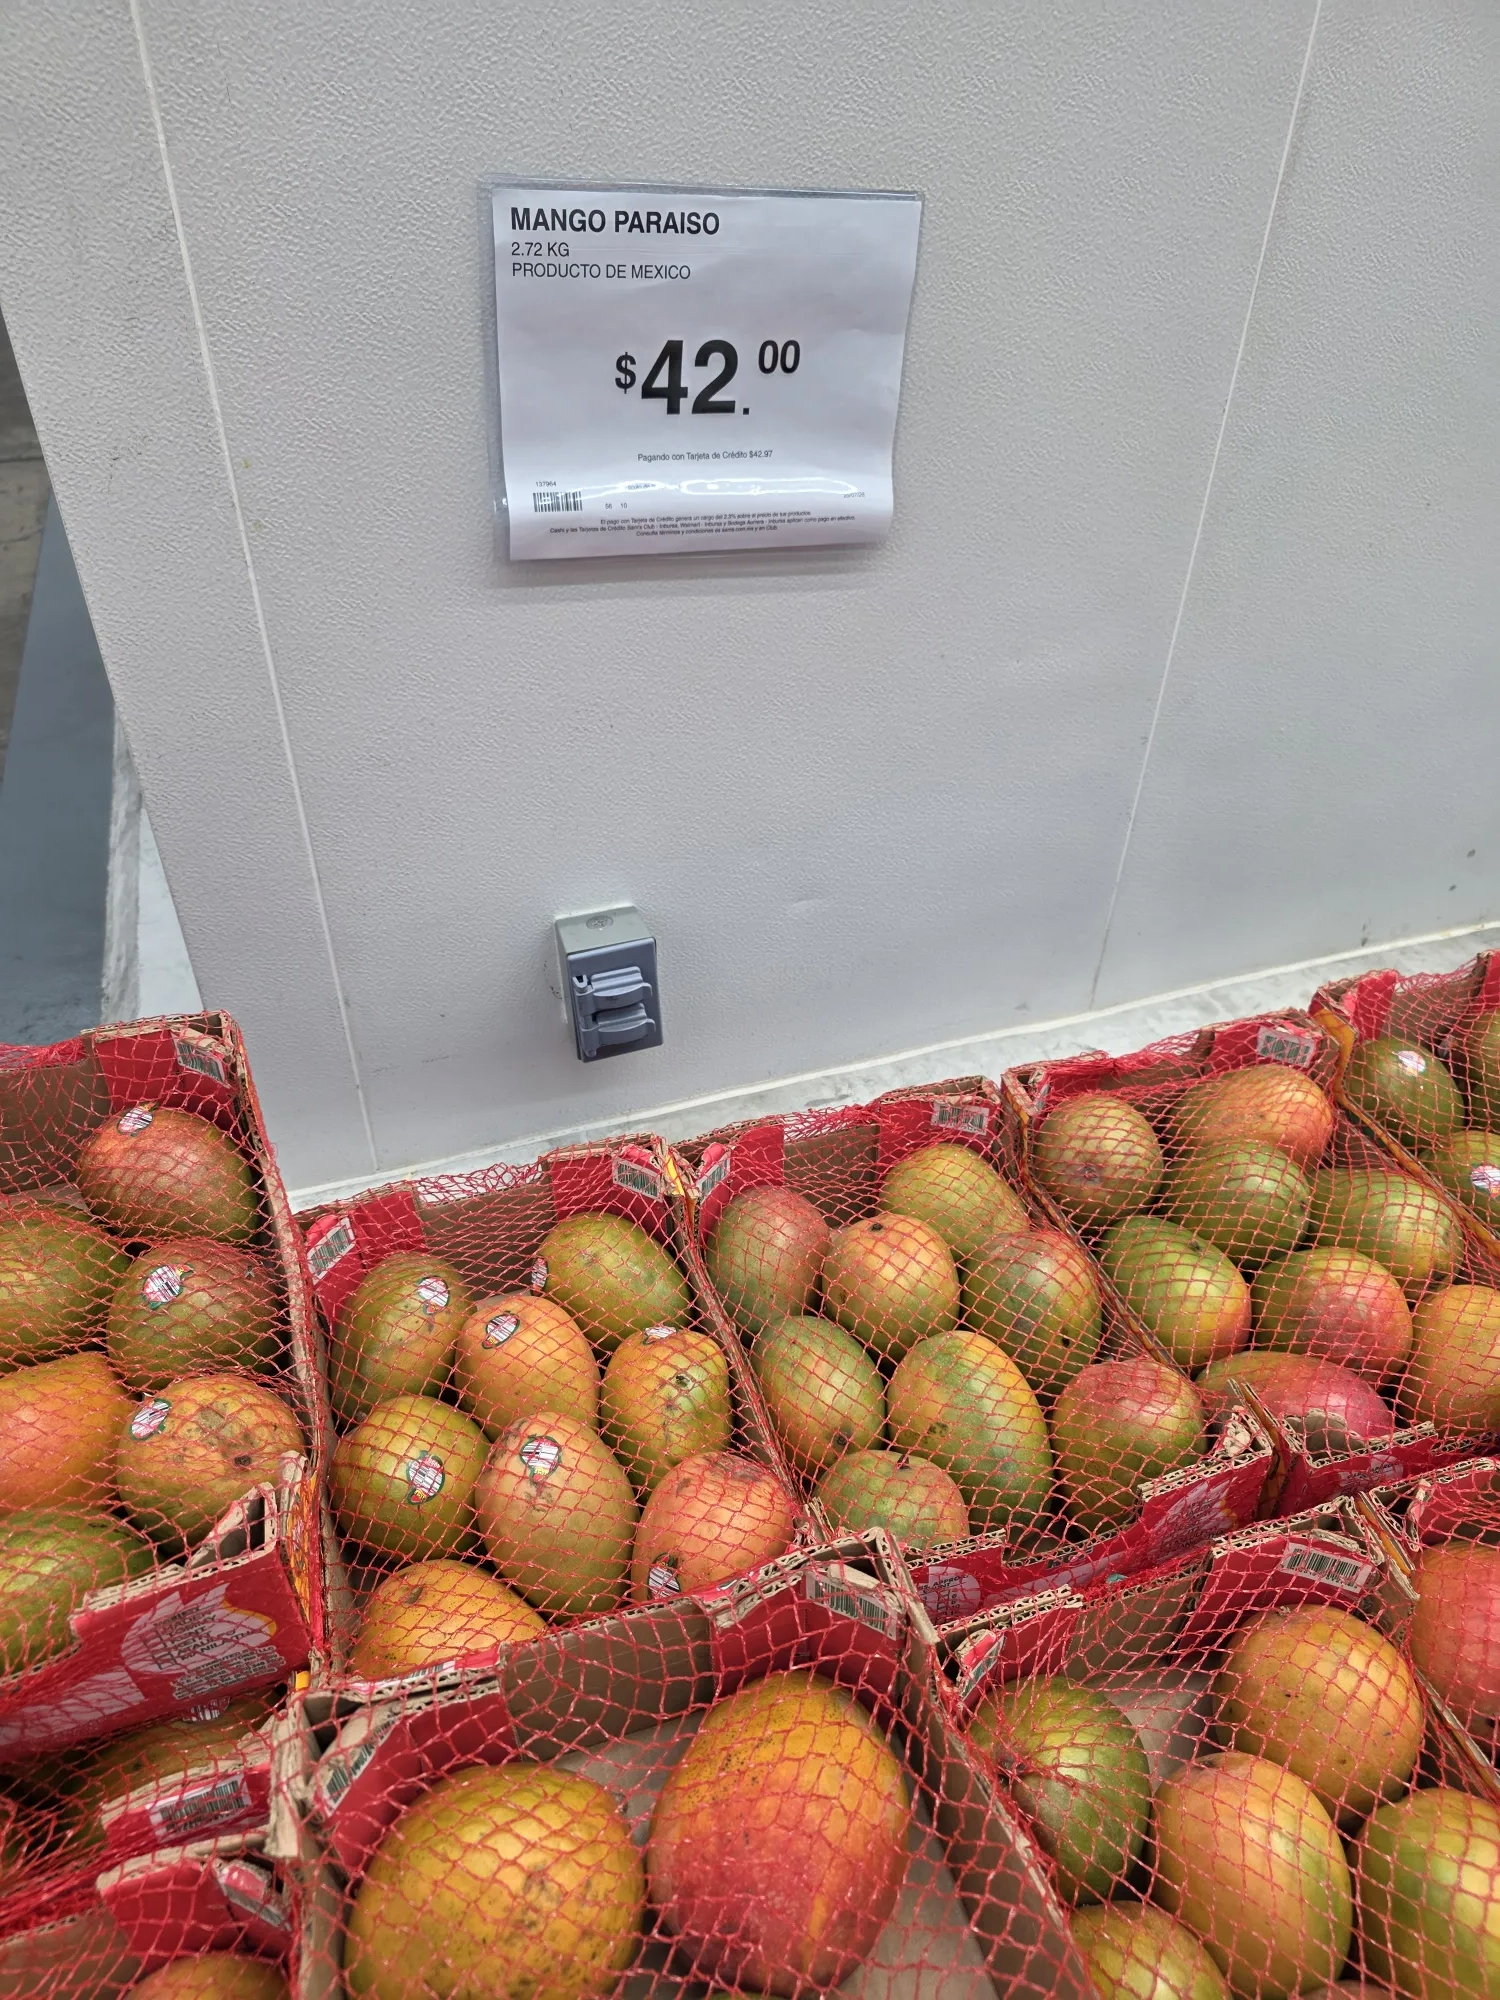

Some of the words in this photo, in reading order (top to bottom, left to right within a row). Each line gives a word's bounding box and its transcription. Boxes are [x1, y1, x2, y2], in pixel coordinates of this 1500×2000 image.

[510, 206, 606, 233] MANGO
[614, 210, 720, 236] PARAISO
[511, 241, 543, 257] 2.72
[547, 242, 570, 258] KG
[512, 262, 601, 279] PRODUCTO
[606, 264, 627, 279] DE
[631, 264, 691, 280] MEXICO
[758, 339, 801, 375] 00
[637, 453, 670, 463] Pagando
[686, 452, 710, 462] Tarjeta
[711, 451, 721, 460] de
[722, 450, 748, 459] Crédito
[749, 449, 774, 459] $42.97
[631, 517, 648, 525] Tarjeta
